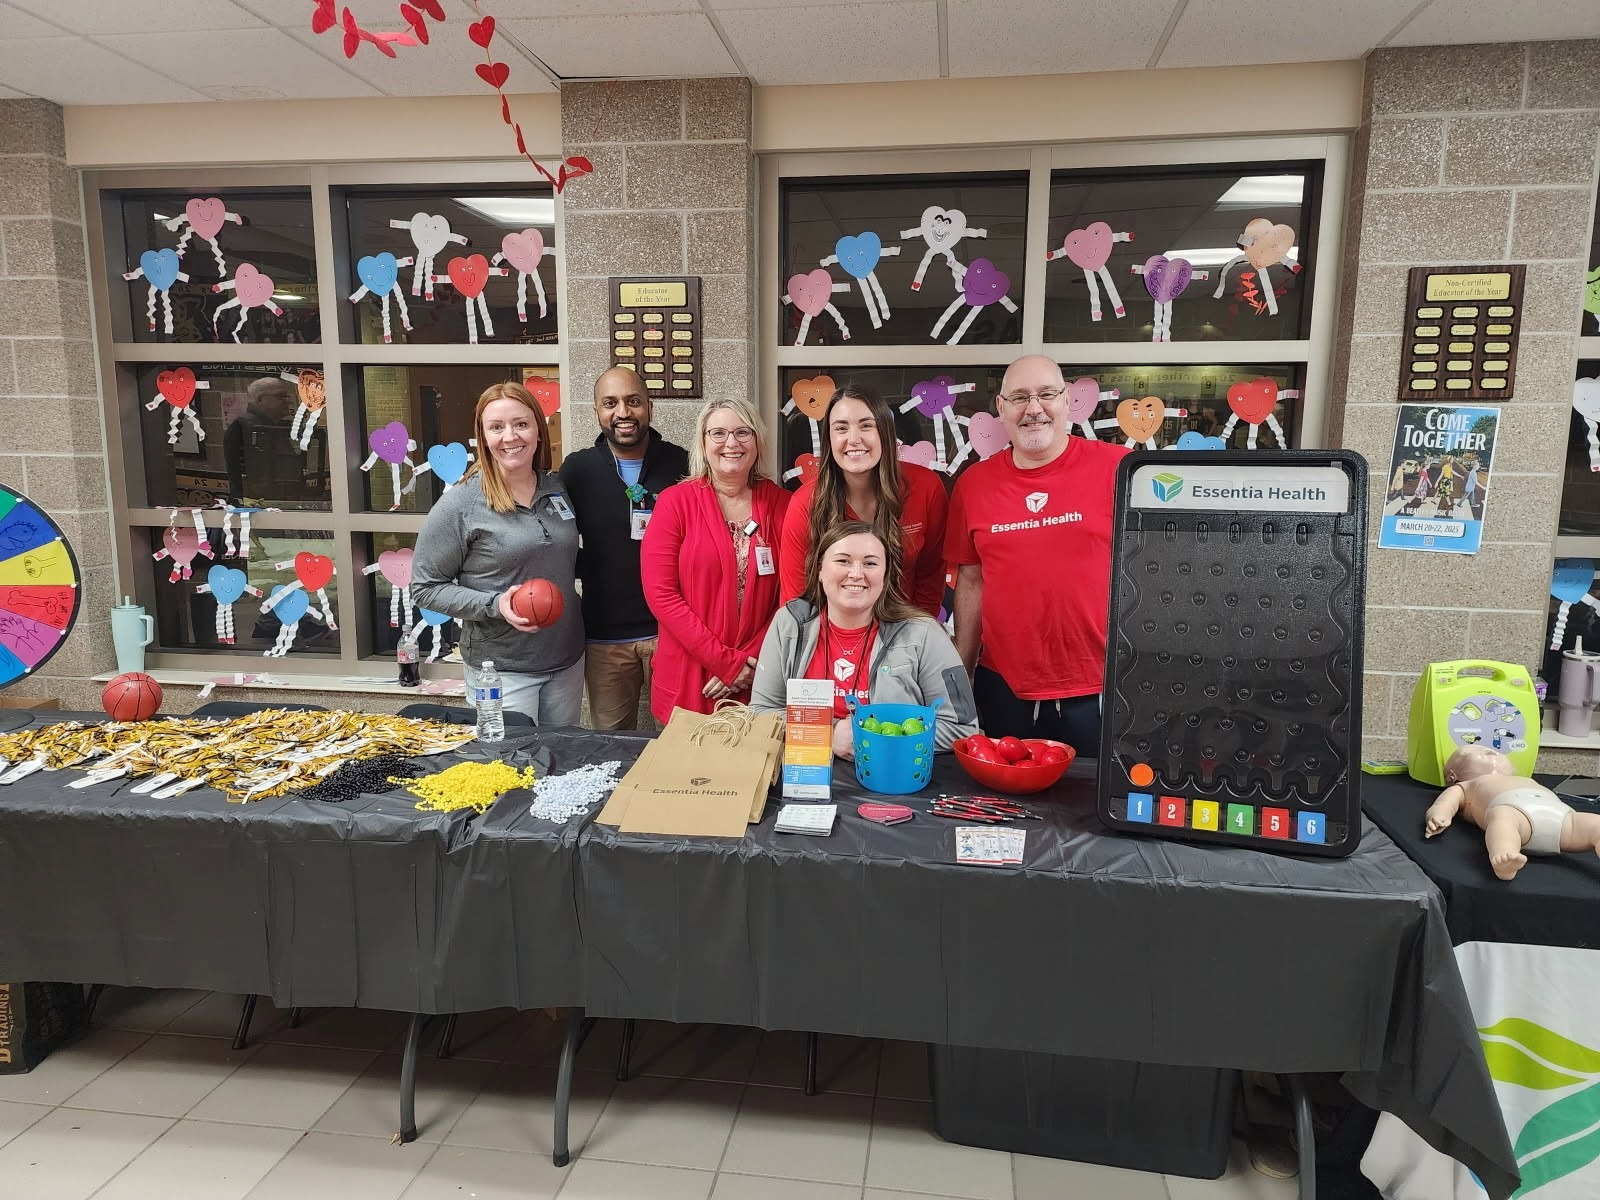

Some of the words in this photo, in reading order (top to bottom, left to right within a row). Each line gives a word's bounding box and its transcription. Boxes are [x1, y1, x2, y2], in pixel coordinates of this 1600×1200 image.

[635, 295, 642, 303] of
[643, 295, 654, 303] the
[1433, 289, 1464, 297] Educator
[1465, 288, 1473, 296] of
[1474, 288, 1485, 296] the
[1425, 408, 1472, 432] COME
[1402, 424, 1487, 452] TOGETHER
[1192, 485, 1263, 499] Essentia
[1268, 487, 1326, 501] Health
[991, 519, 1040, 534] Essentia
[1042, 511, 1083, 527] Health
[1400, 522, 1423, 531] MARCH
[1444, 525, 1459, 533] 2025
[652, 788, 699, 796] Essentia
[1136, 800, 1143, 816] 1
[1167, 803, 1176, 819] 2
[1201, 807, 1210, 824] 3
[1235, 811, 1244, 827] 4
[1270, 815, 1280, 832] 5
[1306, 819, 1316, 835] 6
